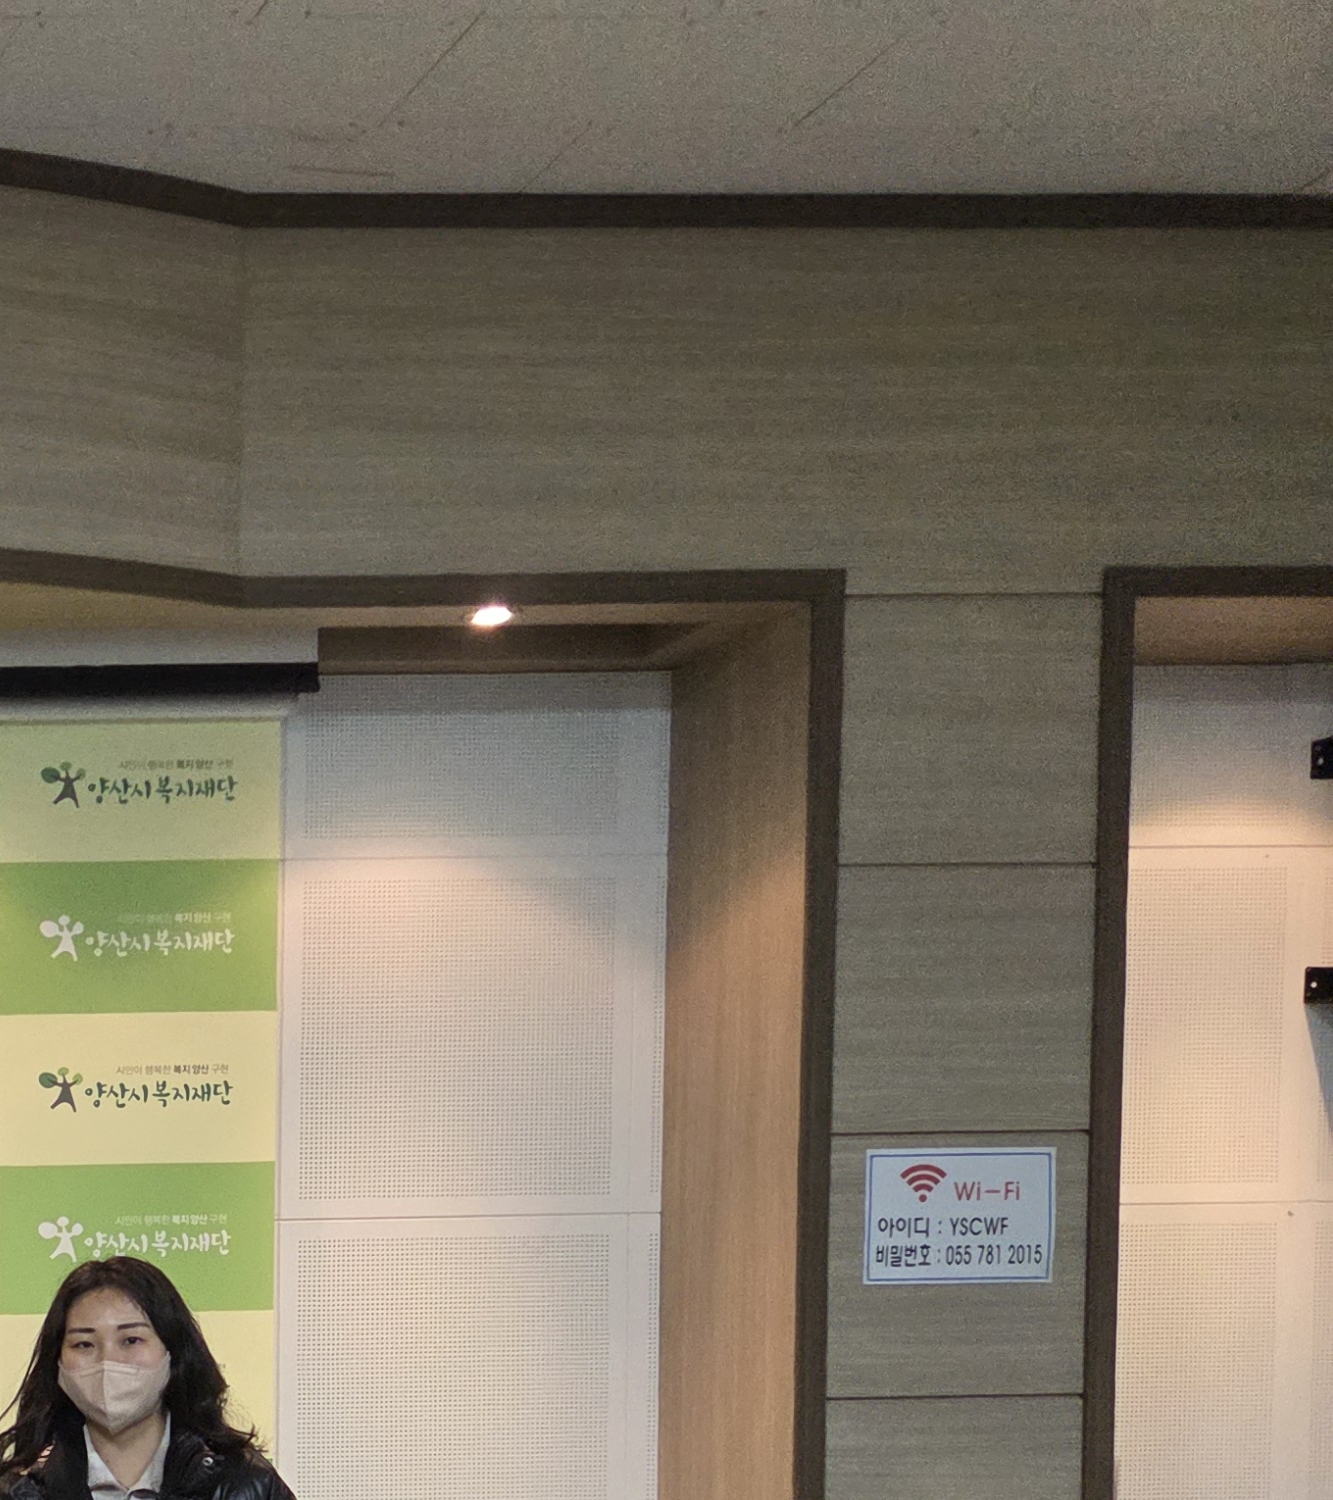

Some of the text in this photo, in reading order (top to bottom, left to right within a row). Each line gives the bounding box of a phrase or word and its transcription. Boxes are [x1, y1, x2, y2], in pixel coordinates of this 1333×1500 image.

[878, 1217, 930, 1238] 아이디
[949, 1217, 1009, 1236] YSCWF
[875, 1244, 932, 1267] 비밀번호
[945, 1245, 972, 1265] 055
[977, 1244, 1002, 1265] 781
[1008, 1244, 1043, 1265] 2015
